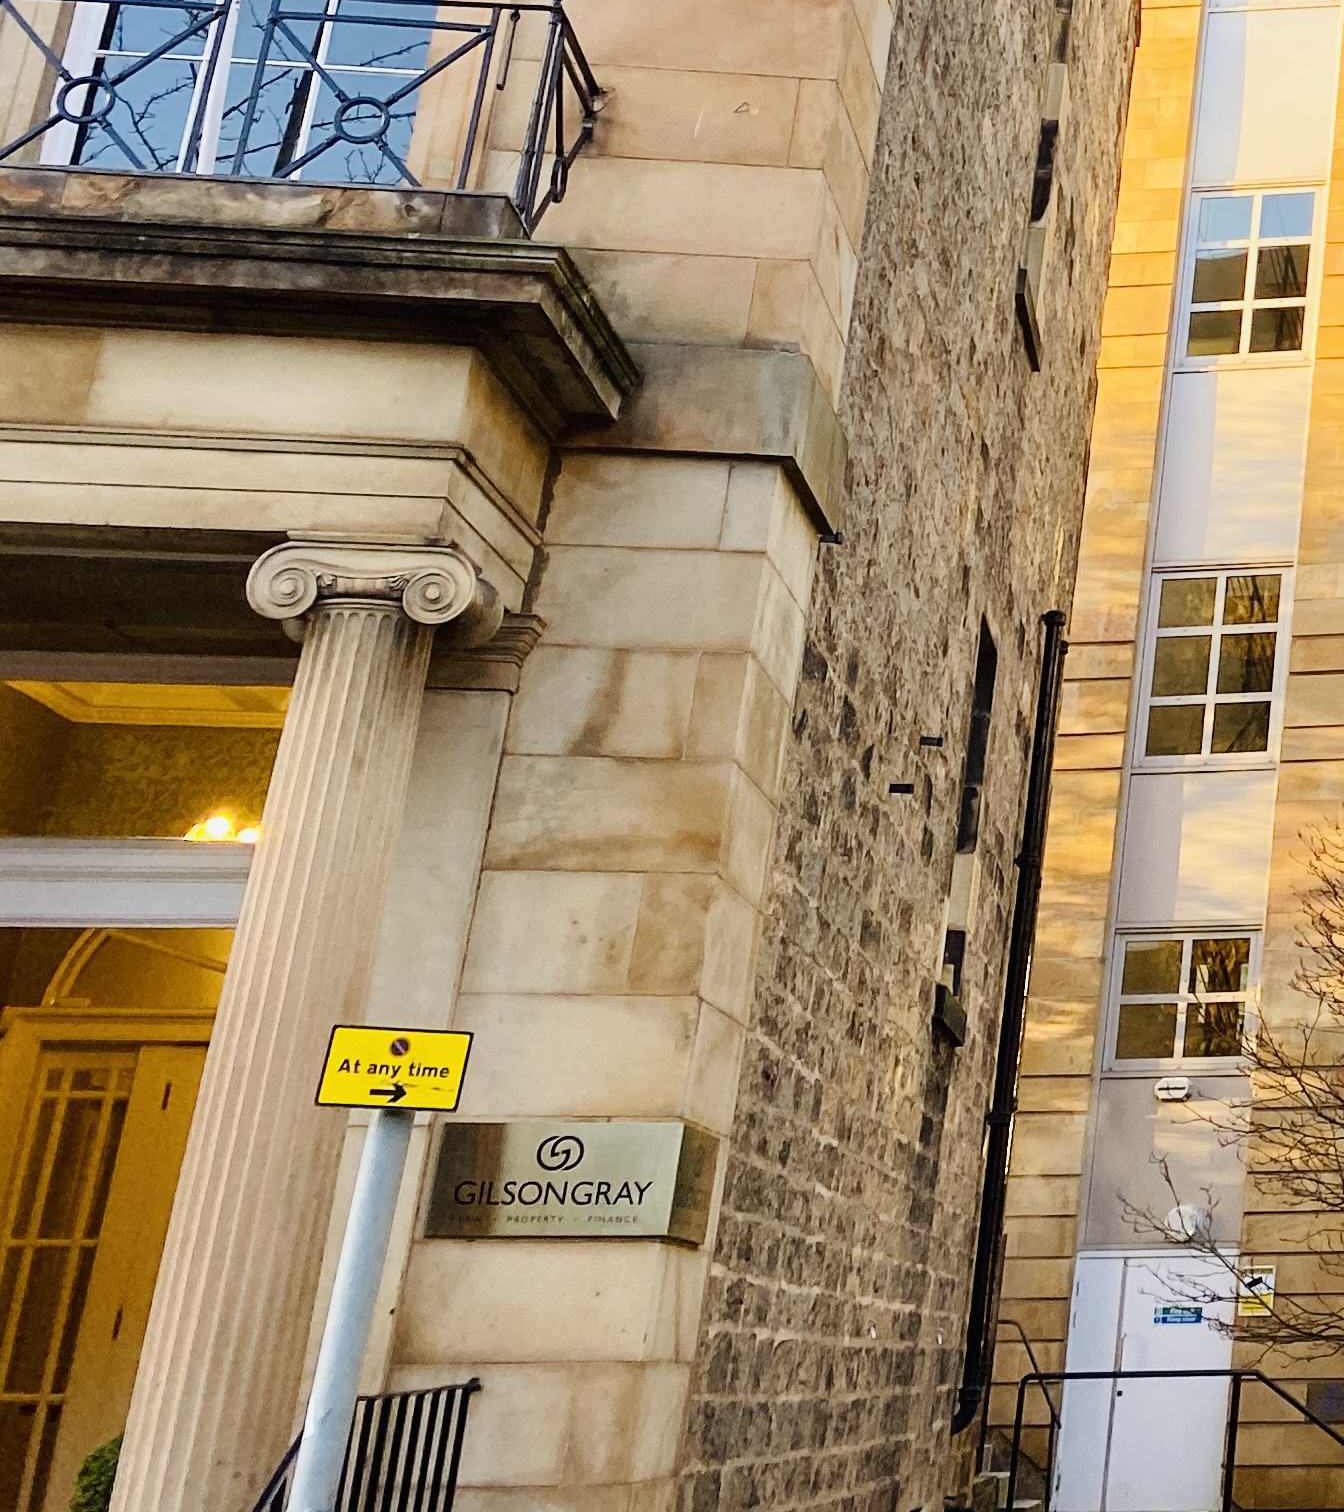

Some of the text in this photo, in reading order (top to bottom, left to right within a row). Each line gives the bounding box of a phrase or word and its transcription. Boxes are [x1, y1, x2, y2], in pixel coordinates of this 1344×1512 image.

[338, 1058, 450, 1079] At any time
[454, 1180, 654, 1206] GILSONGRAY
[587, 1215, 639, 1224] FINANCE
